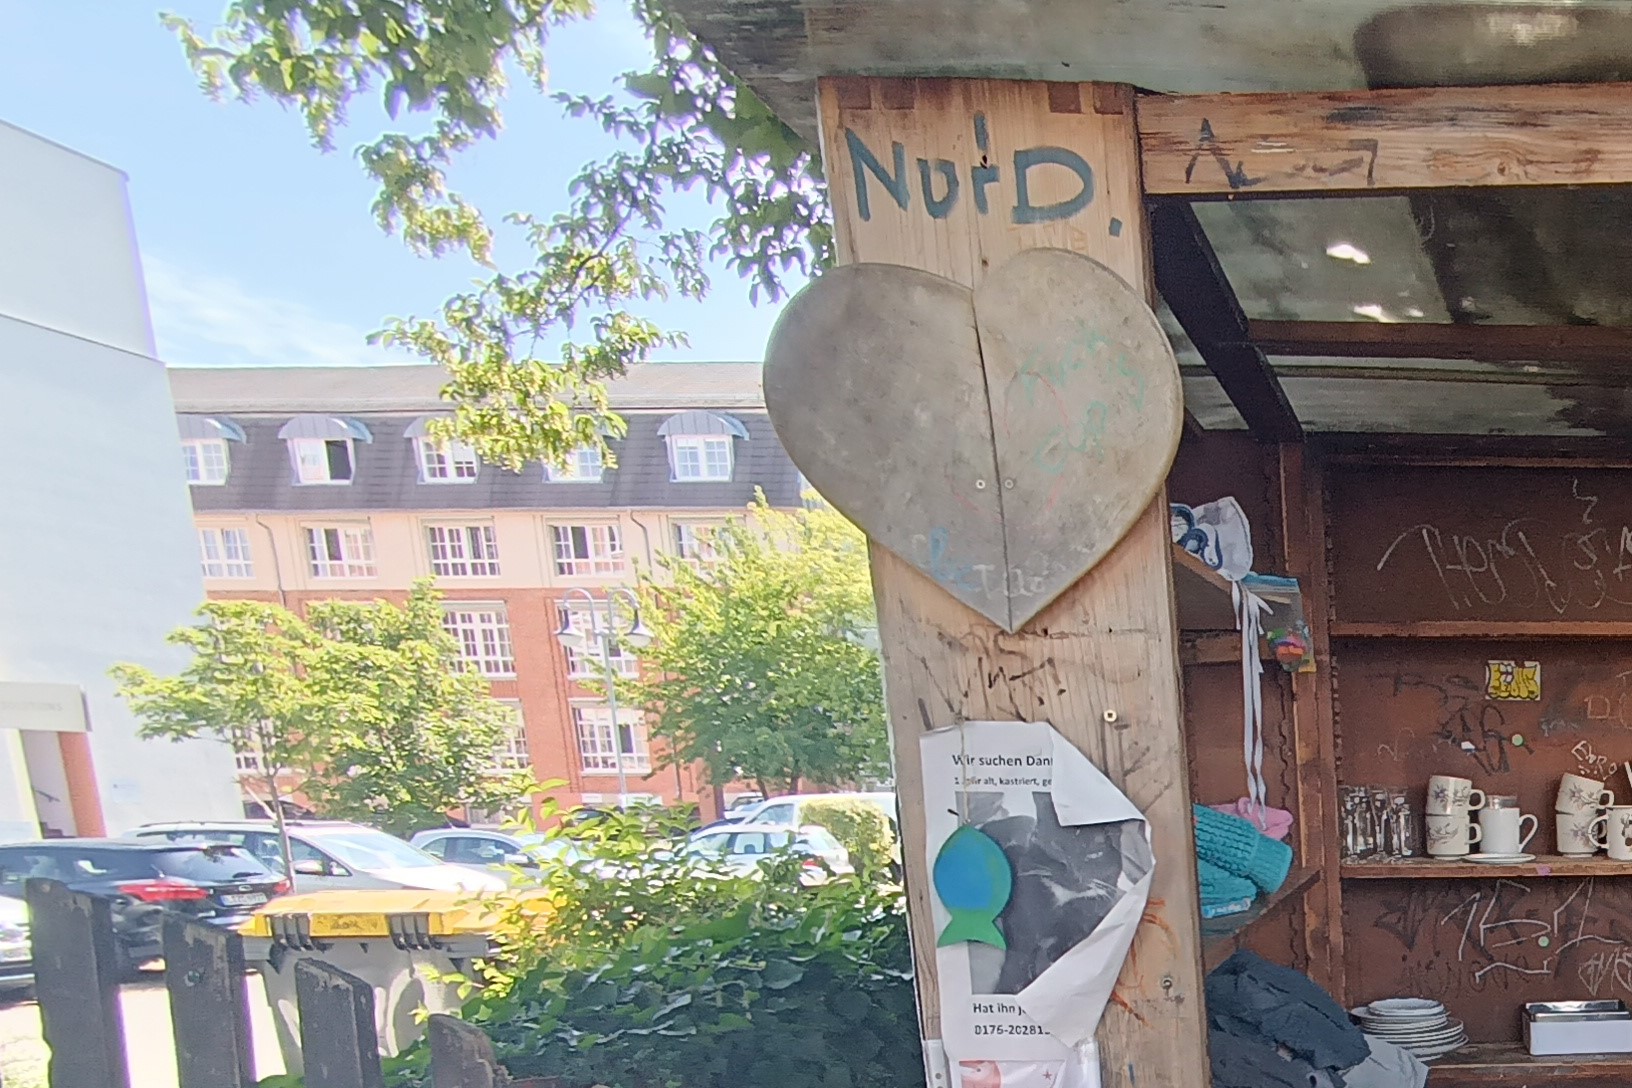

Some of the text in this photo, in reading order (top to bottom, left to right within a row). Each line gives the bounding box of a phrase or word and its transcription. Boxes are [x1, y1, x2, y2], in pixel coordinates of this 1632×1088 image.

[979, 754, 1023, 767] suchen
[1026, 755, 1054, 766] Dan
[984, 776, 998, 787] alt,
[999, 776, 1040, 786] kastriert,
[973, 1003, 995, 1014] Hat
[997, 1003, 1016, 1013] ihn
[974, 1024, 1051, 1036] 0176-20281
